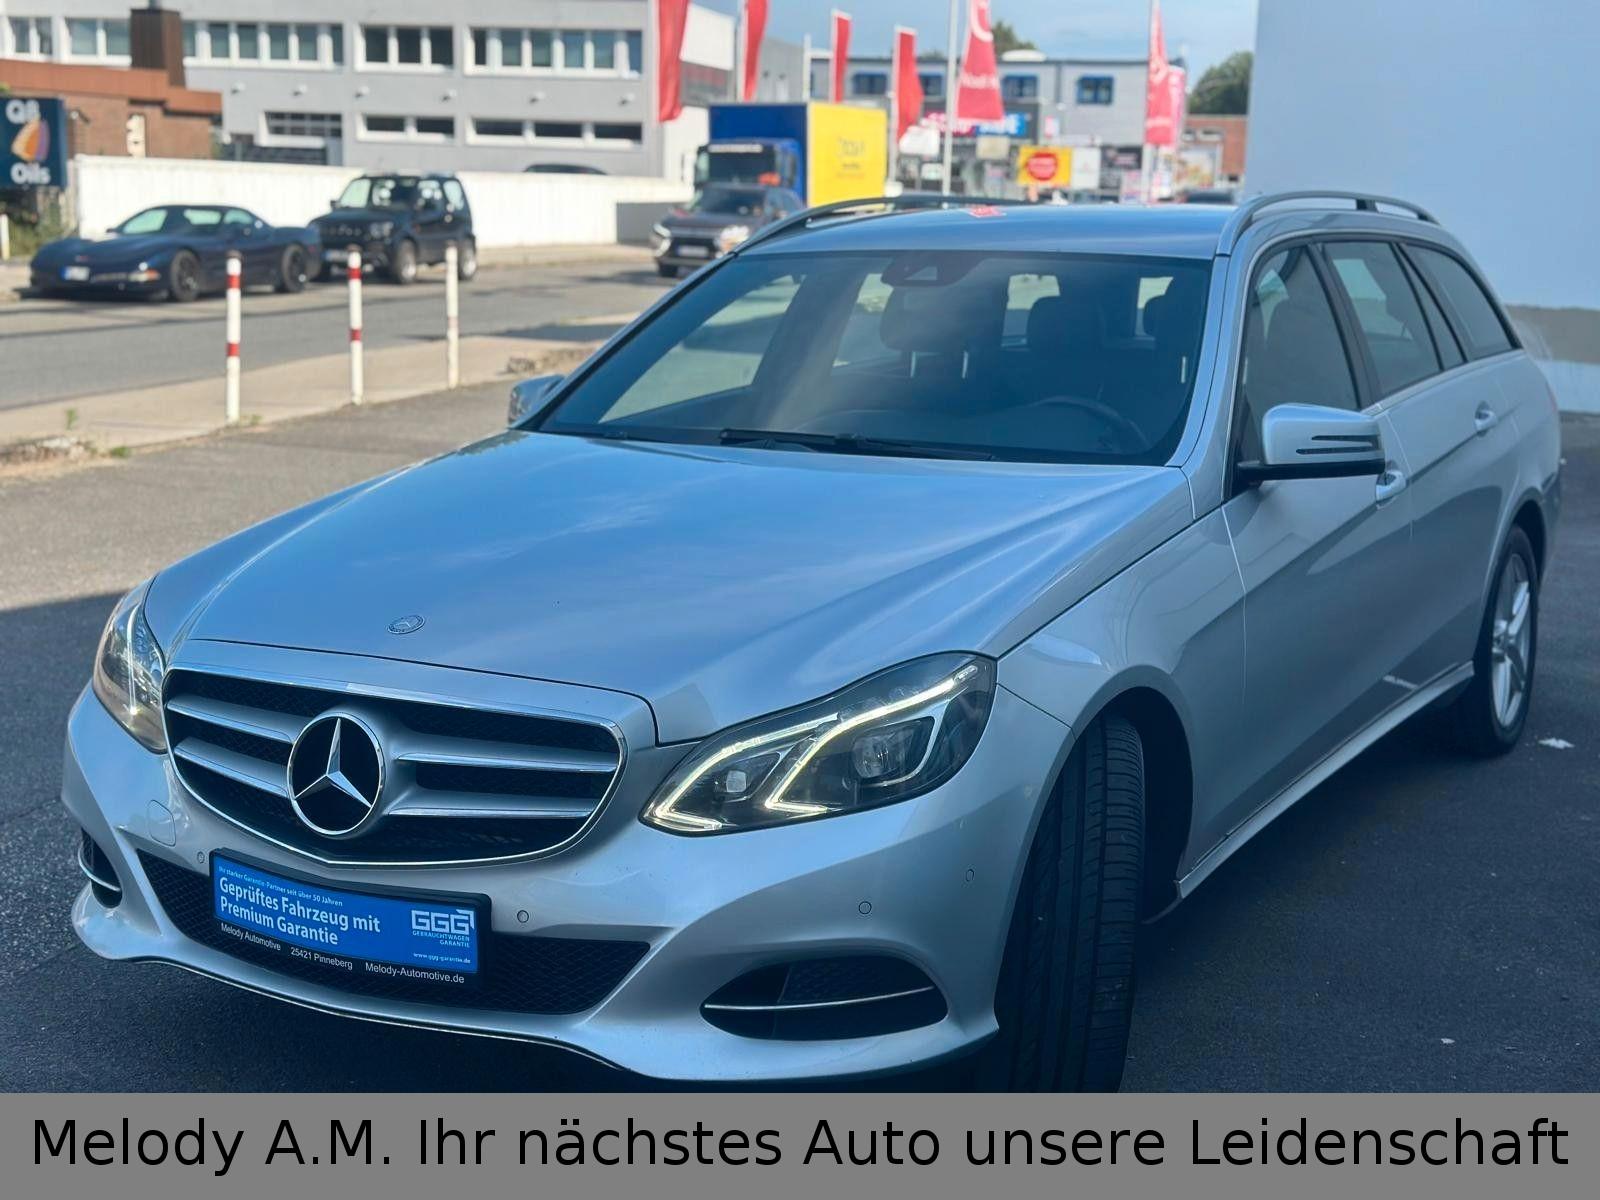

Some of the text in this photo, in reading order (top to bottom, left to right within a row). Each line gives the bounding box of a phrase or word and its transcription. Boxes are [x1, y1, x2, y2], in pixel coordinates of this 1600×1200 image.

[218, 865, 343, 907] Ihr starker Garantie-Partner seit über 50 Jahren
[219, 876, 381, 933] Geprüftes Fahrzeug mit
[220, 895, 339, 945] Premium Garantie
[411, 909, 472, 936] GGG
[412, 930, 470, 942] GEBRAUCHTWAGEN
[220, 922, 465, 984] Melody Automotive 25421 Pinneberg Melody-Automotive.de
[439, 940, 470, 948] GARANTIE
